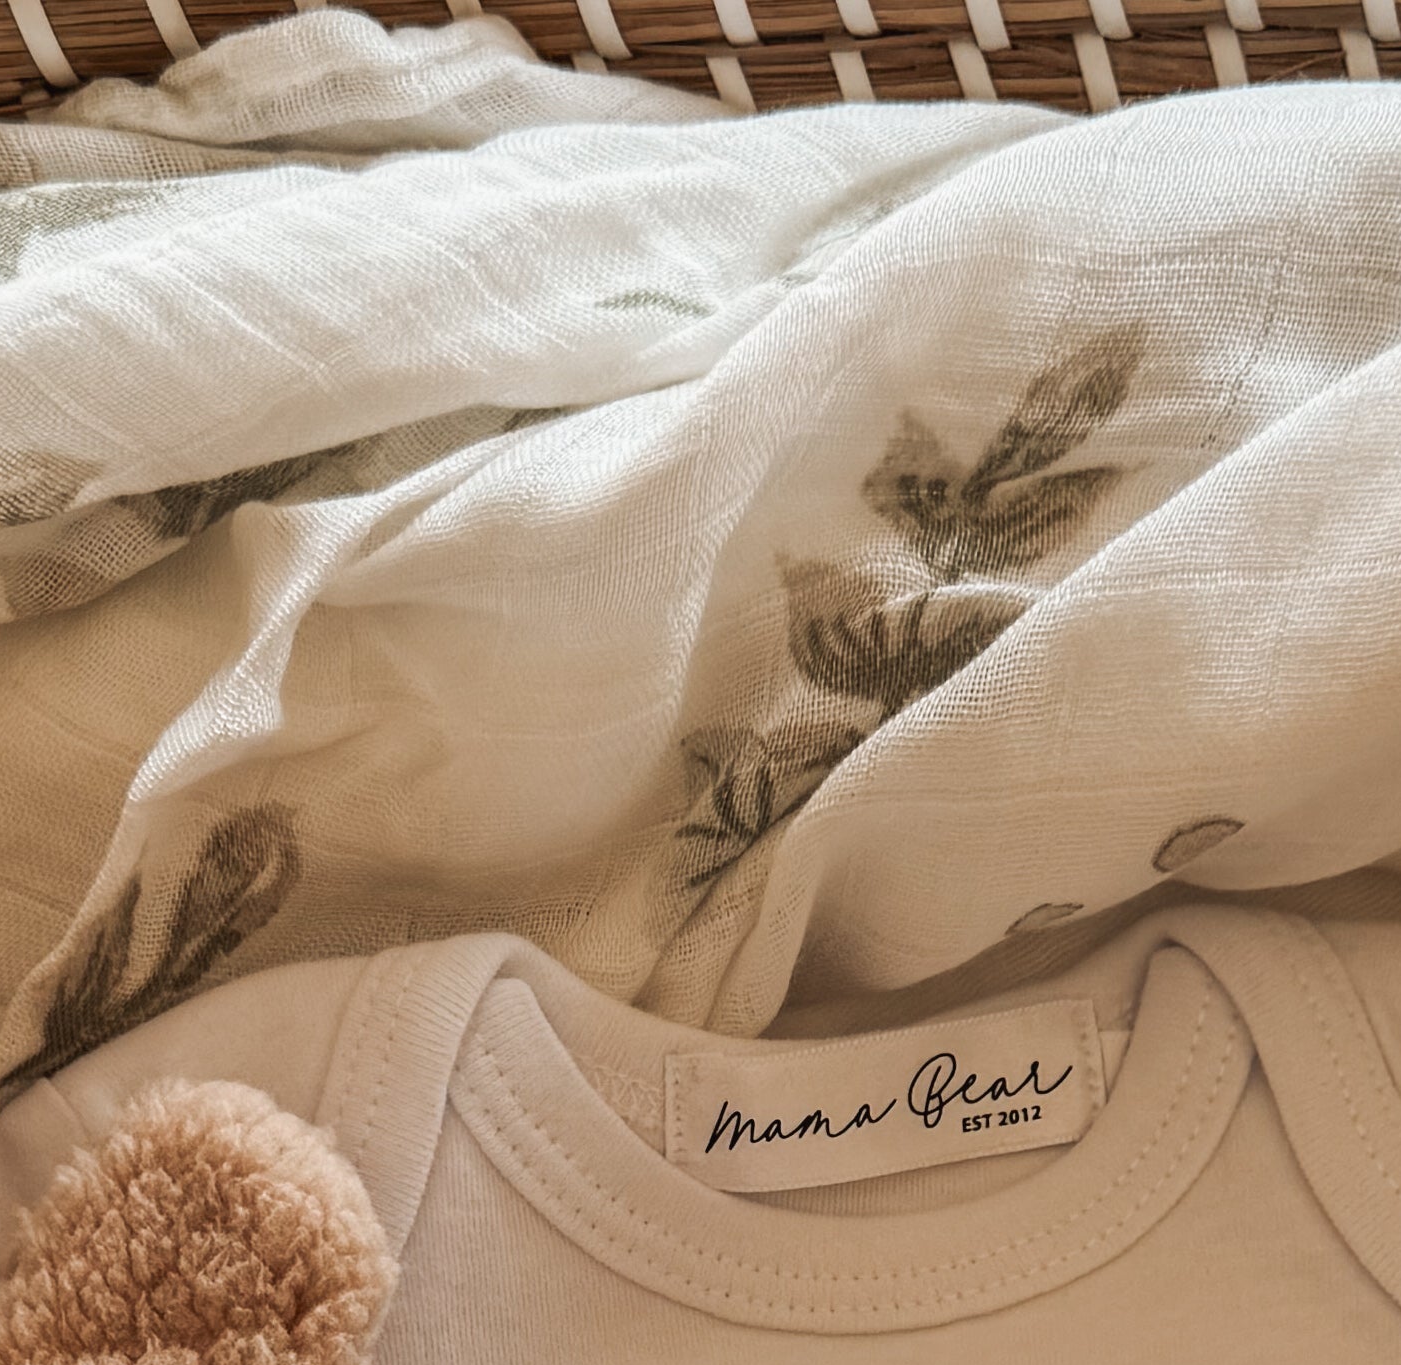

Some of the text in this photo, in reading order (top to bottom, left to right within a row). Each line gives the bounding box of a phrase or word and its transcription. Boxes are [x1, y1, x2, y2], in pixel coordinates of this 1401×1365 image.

[907, 1052, 1073, 1128] Bear
[961, 1105, 1042, 1133] EST 2012
